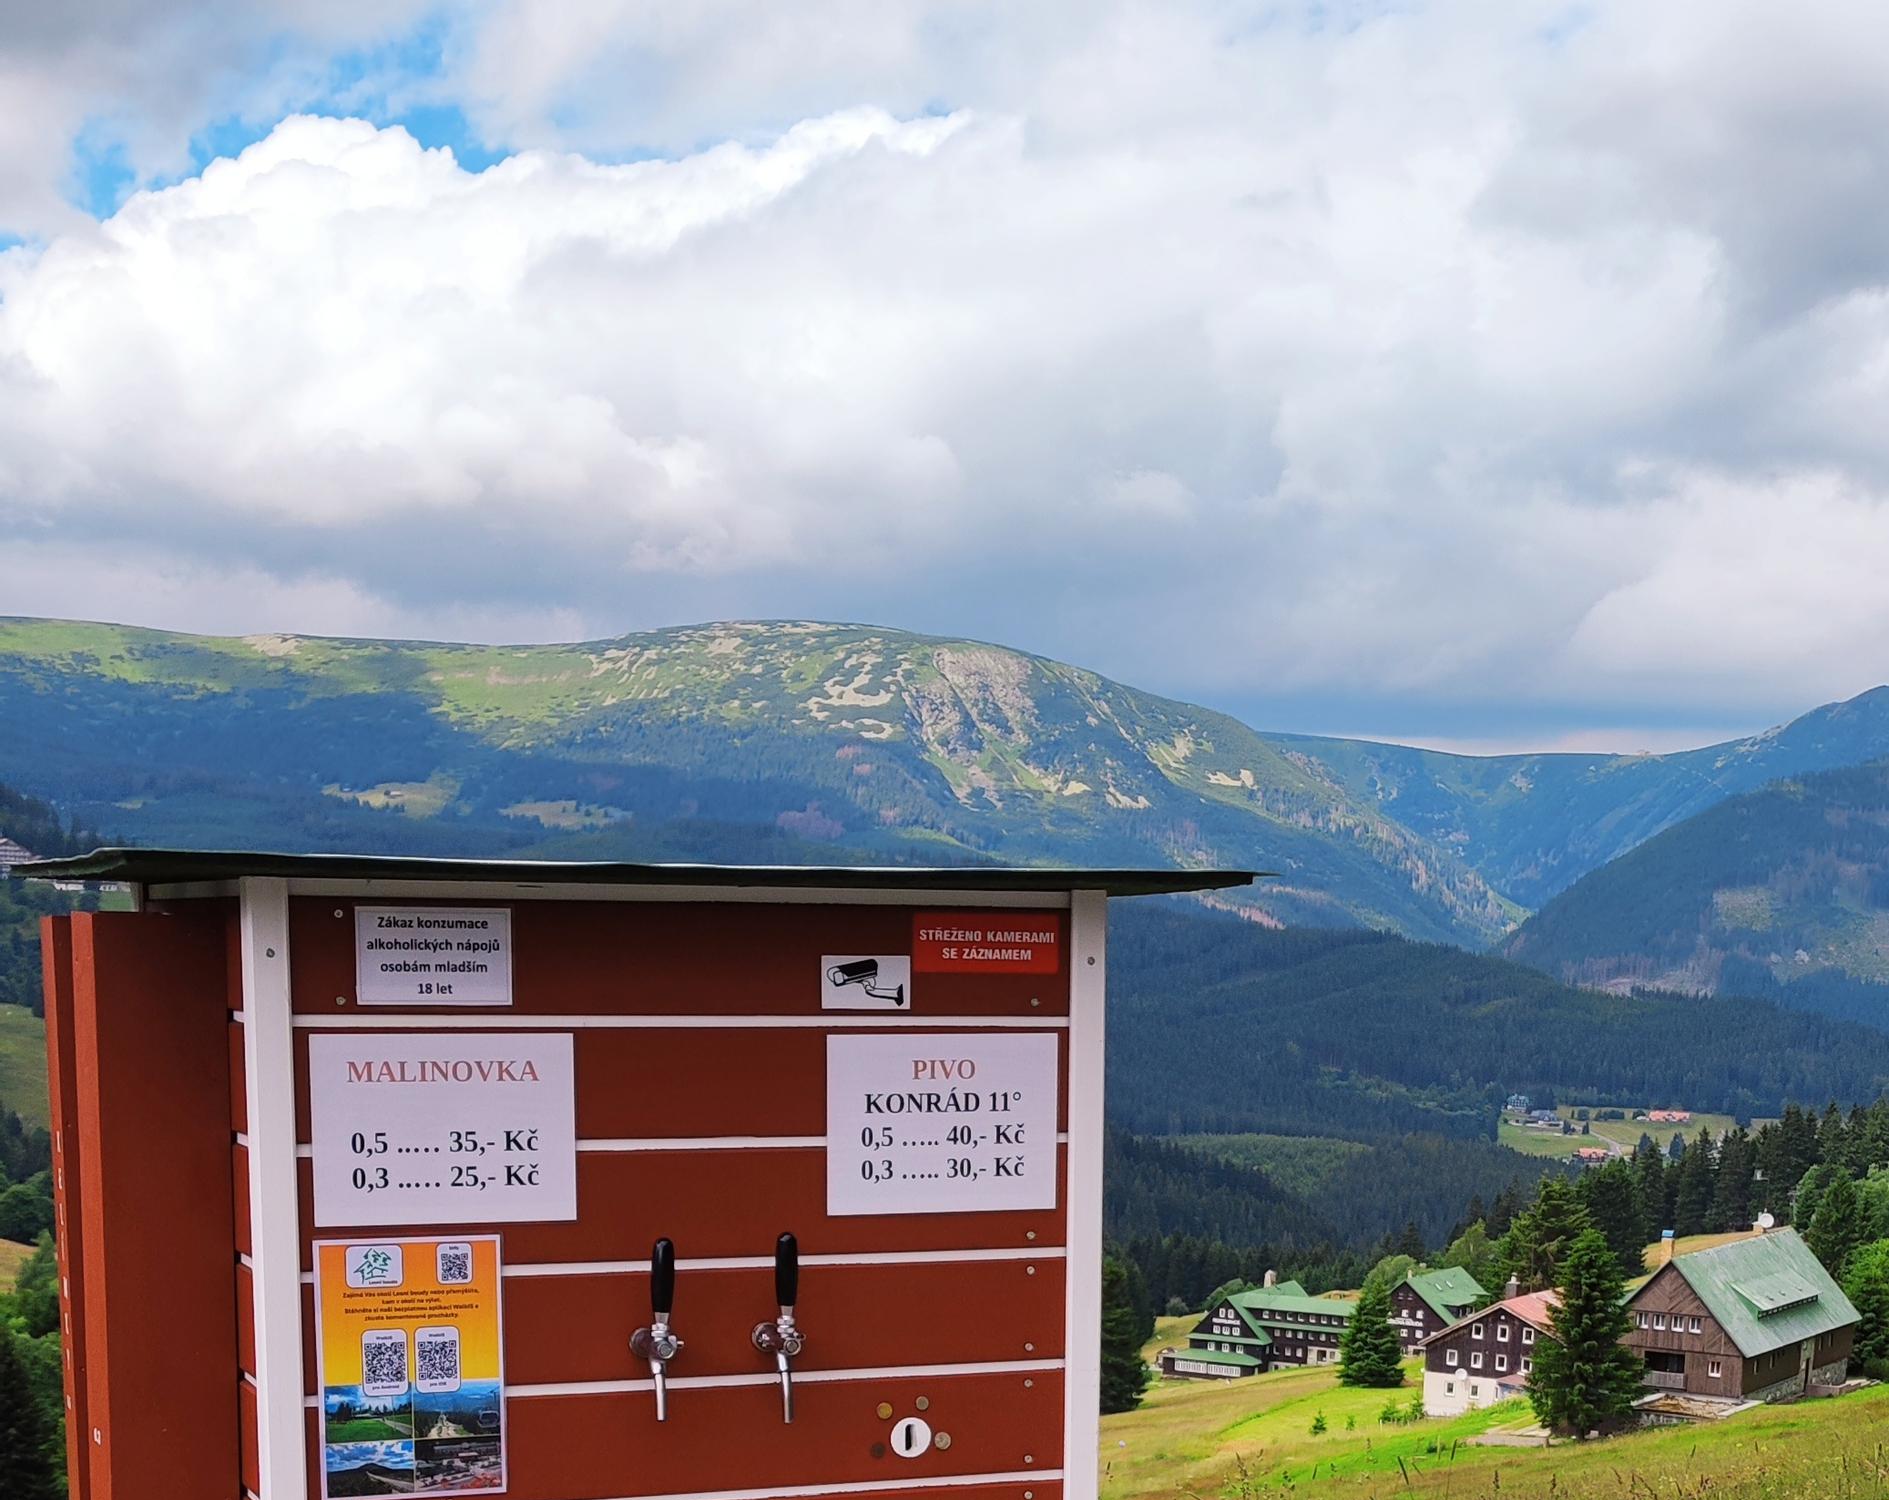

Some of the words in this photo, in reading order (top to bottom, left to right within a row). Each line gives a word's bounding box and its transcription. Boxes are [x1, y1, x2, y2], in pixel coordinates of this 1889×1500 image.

[378, 916, 413, 929] Zákaz
[417, 916, 488, 929] konzumace
[920, 927, 982, 941] STŘEŽENO
[987, 931, 1055, 943] KAMERAMI
[367, 938, 453, 953] alkoholických
[457, 938, 500, 953] nápojů
[942, 948, 958, 959] SE
[963, 945, 1032, 960] ZÁZNAMEM
[380, 959, 430, 973] osobám
[435, 960, 488, 973] mladším
[418, 983, 432, 995] 18
[437, 983, 453, 995] let
[346, 1061, 540, 1083] MALINOVKA
[912, 1060, 976, 1080] PIVO
[864, 1087, 980, 1113] KONRÁD
[989, 1091, 1022, 1112] 11°
[351, 1132, 388, 1158] 0,5
[449, 1131, 495, 1156] 35,-
[503, 1129, 539, 1152] Kč
[861, 1127, 894, 1151] 0,5
[946, 1125, 987, 1149] 40,-
[993, 1123, 1025, 1145] Kč
[352, 1167, 389, 1193] 0,3
[450, 1166, 496, 1191] 25,-
[503, 1164, 540, 1186] Kč
[861, 1159, 894, 1184] 0,3
[946, 1158, 987, 1182] 30,-
[993, 1156, 1025, 1177] Kč
